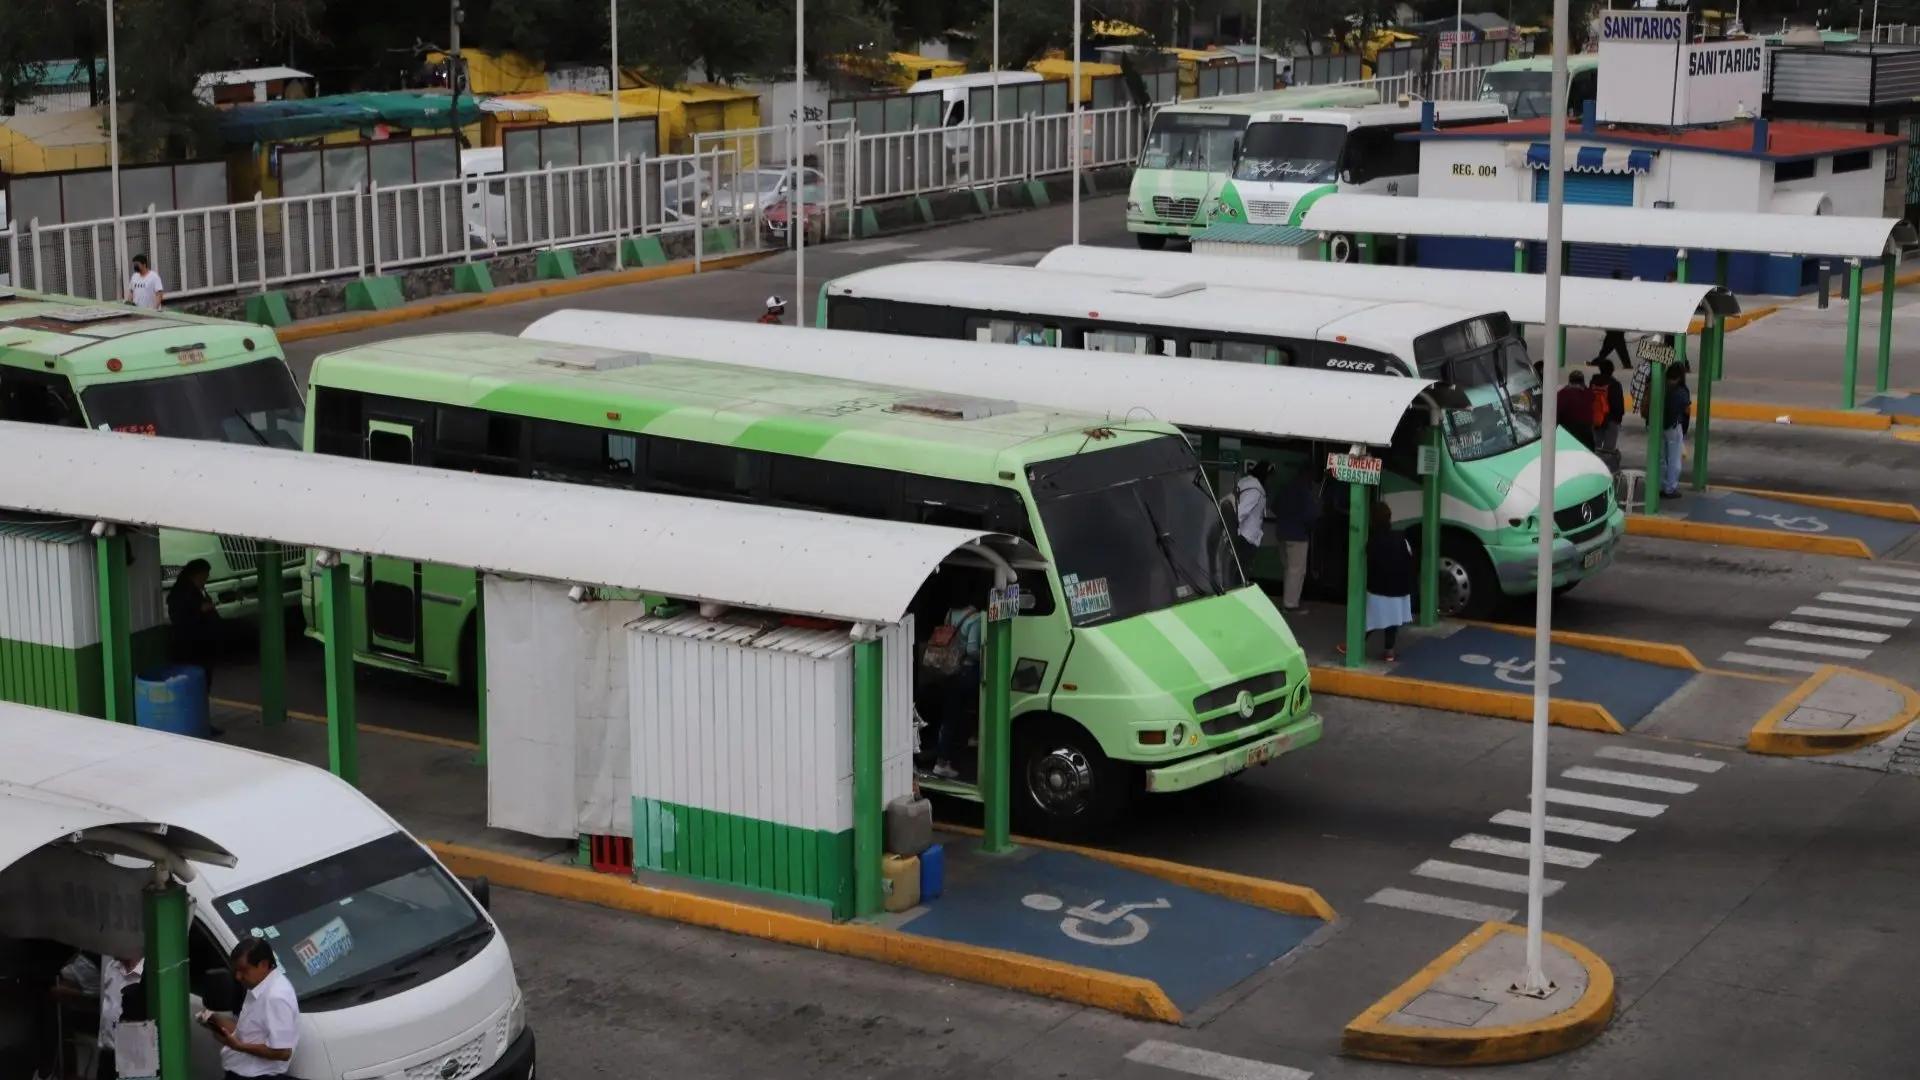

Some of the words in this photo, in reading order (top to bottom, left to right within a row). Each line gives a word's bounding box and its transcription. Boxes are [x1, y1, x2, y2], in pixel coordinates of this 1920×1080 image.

[1604, 16, 1681, 40] SANITARIOS
[1689, 47, 1761, 77] SANITARIOS
[1452, 163, 1474, 176] REG.
[1478, 165, 1497, 177] 004
[1326, 358, 1375, 371] BOXER
[1348, 455, 1381, 472] ORIENTE
[1337, 468, 1380, 485] SEBASTIAN
[1086, 579, 1107, 597] MAYO
